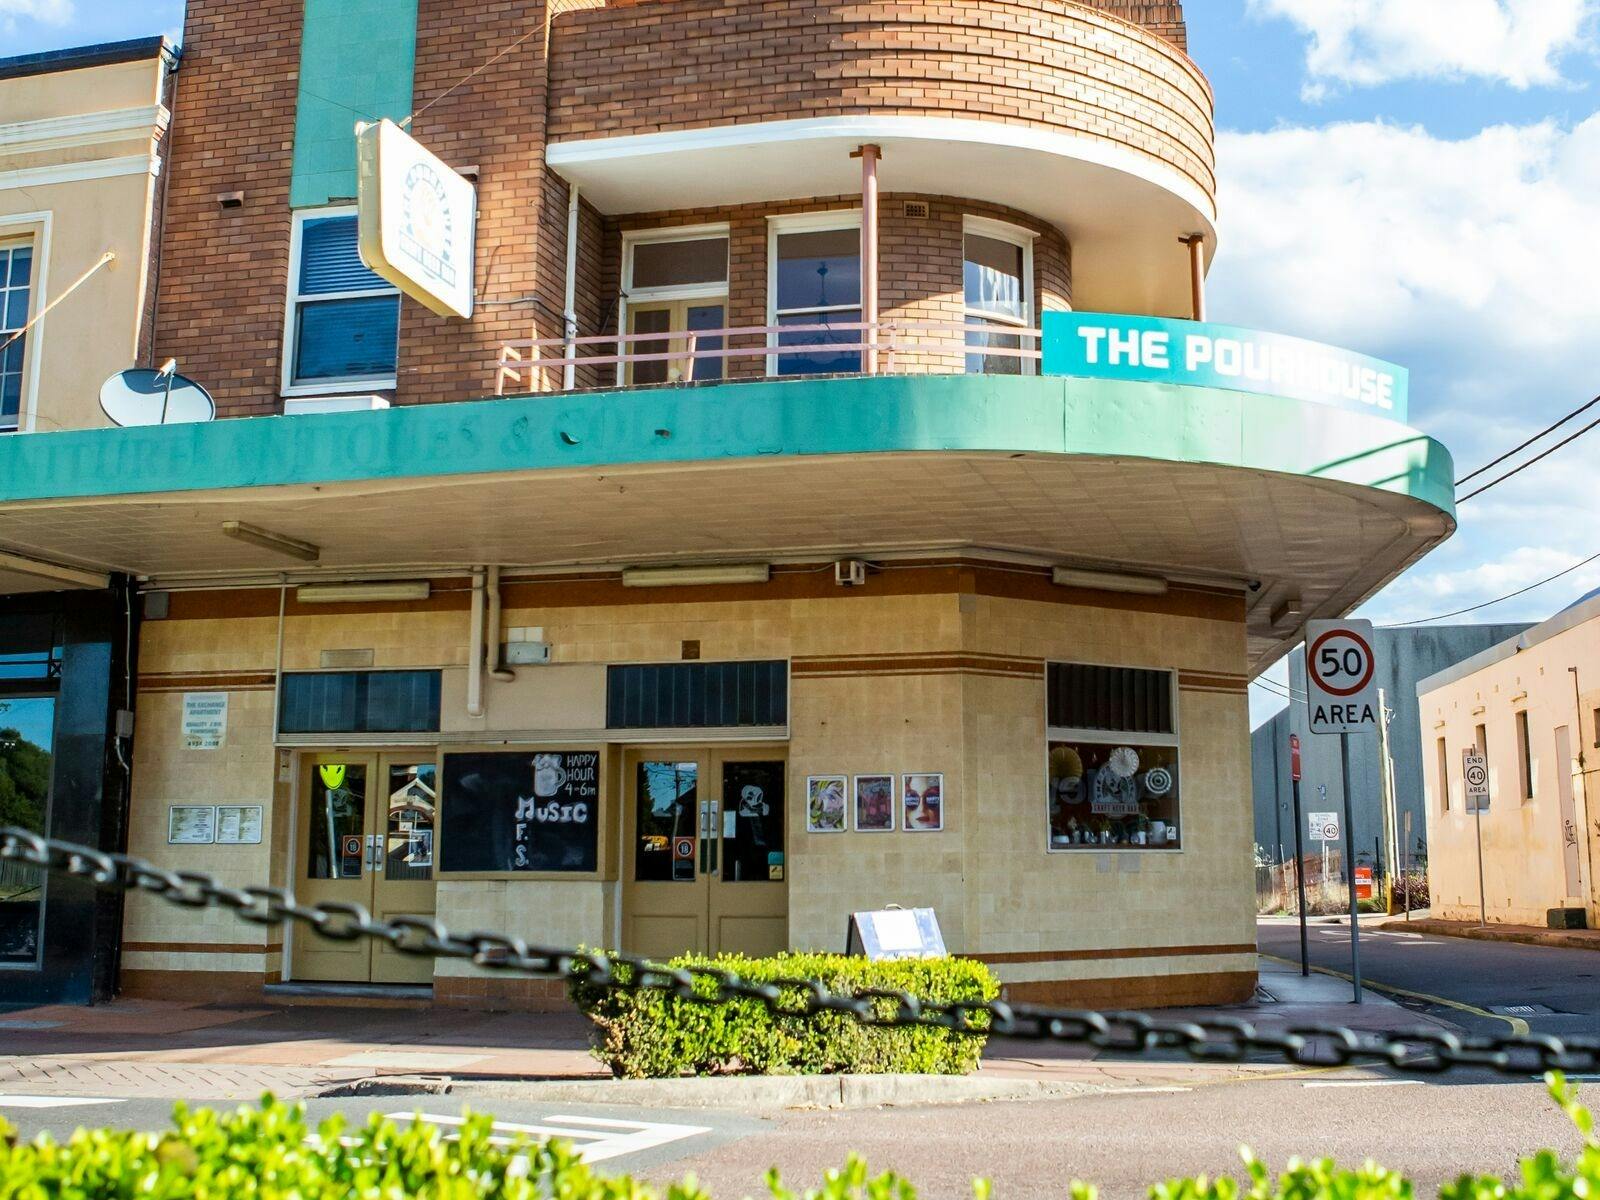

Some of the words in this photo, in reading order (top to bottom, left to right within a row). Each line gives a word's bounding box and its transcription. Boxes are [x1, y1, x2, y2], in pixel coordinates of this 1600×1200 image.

[1077, 325, 1169, 369] THE
[1185, 333, 1393, 410] POURHOUSE
[1320, 647, 1362, 678] 50
[1313, 703, 1376, 725] AREA
[566, 754, 597, 768] HAPPY
[567, 767, 595, 782] HOUR
[1470, 771, 1483, 780] 40
[1326, 827, 1336, 835] 40
[681, 844, 689, 854] 18
